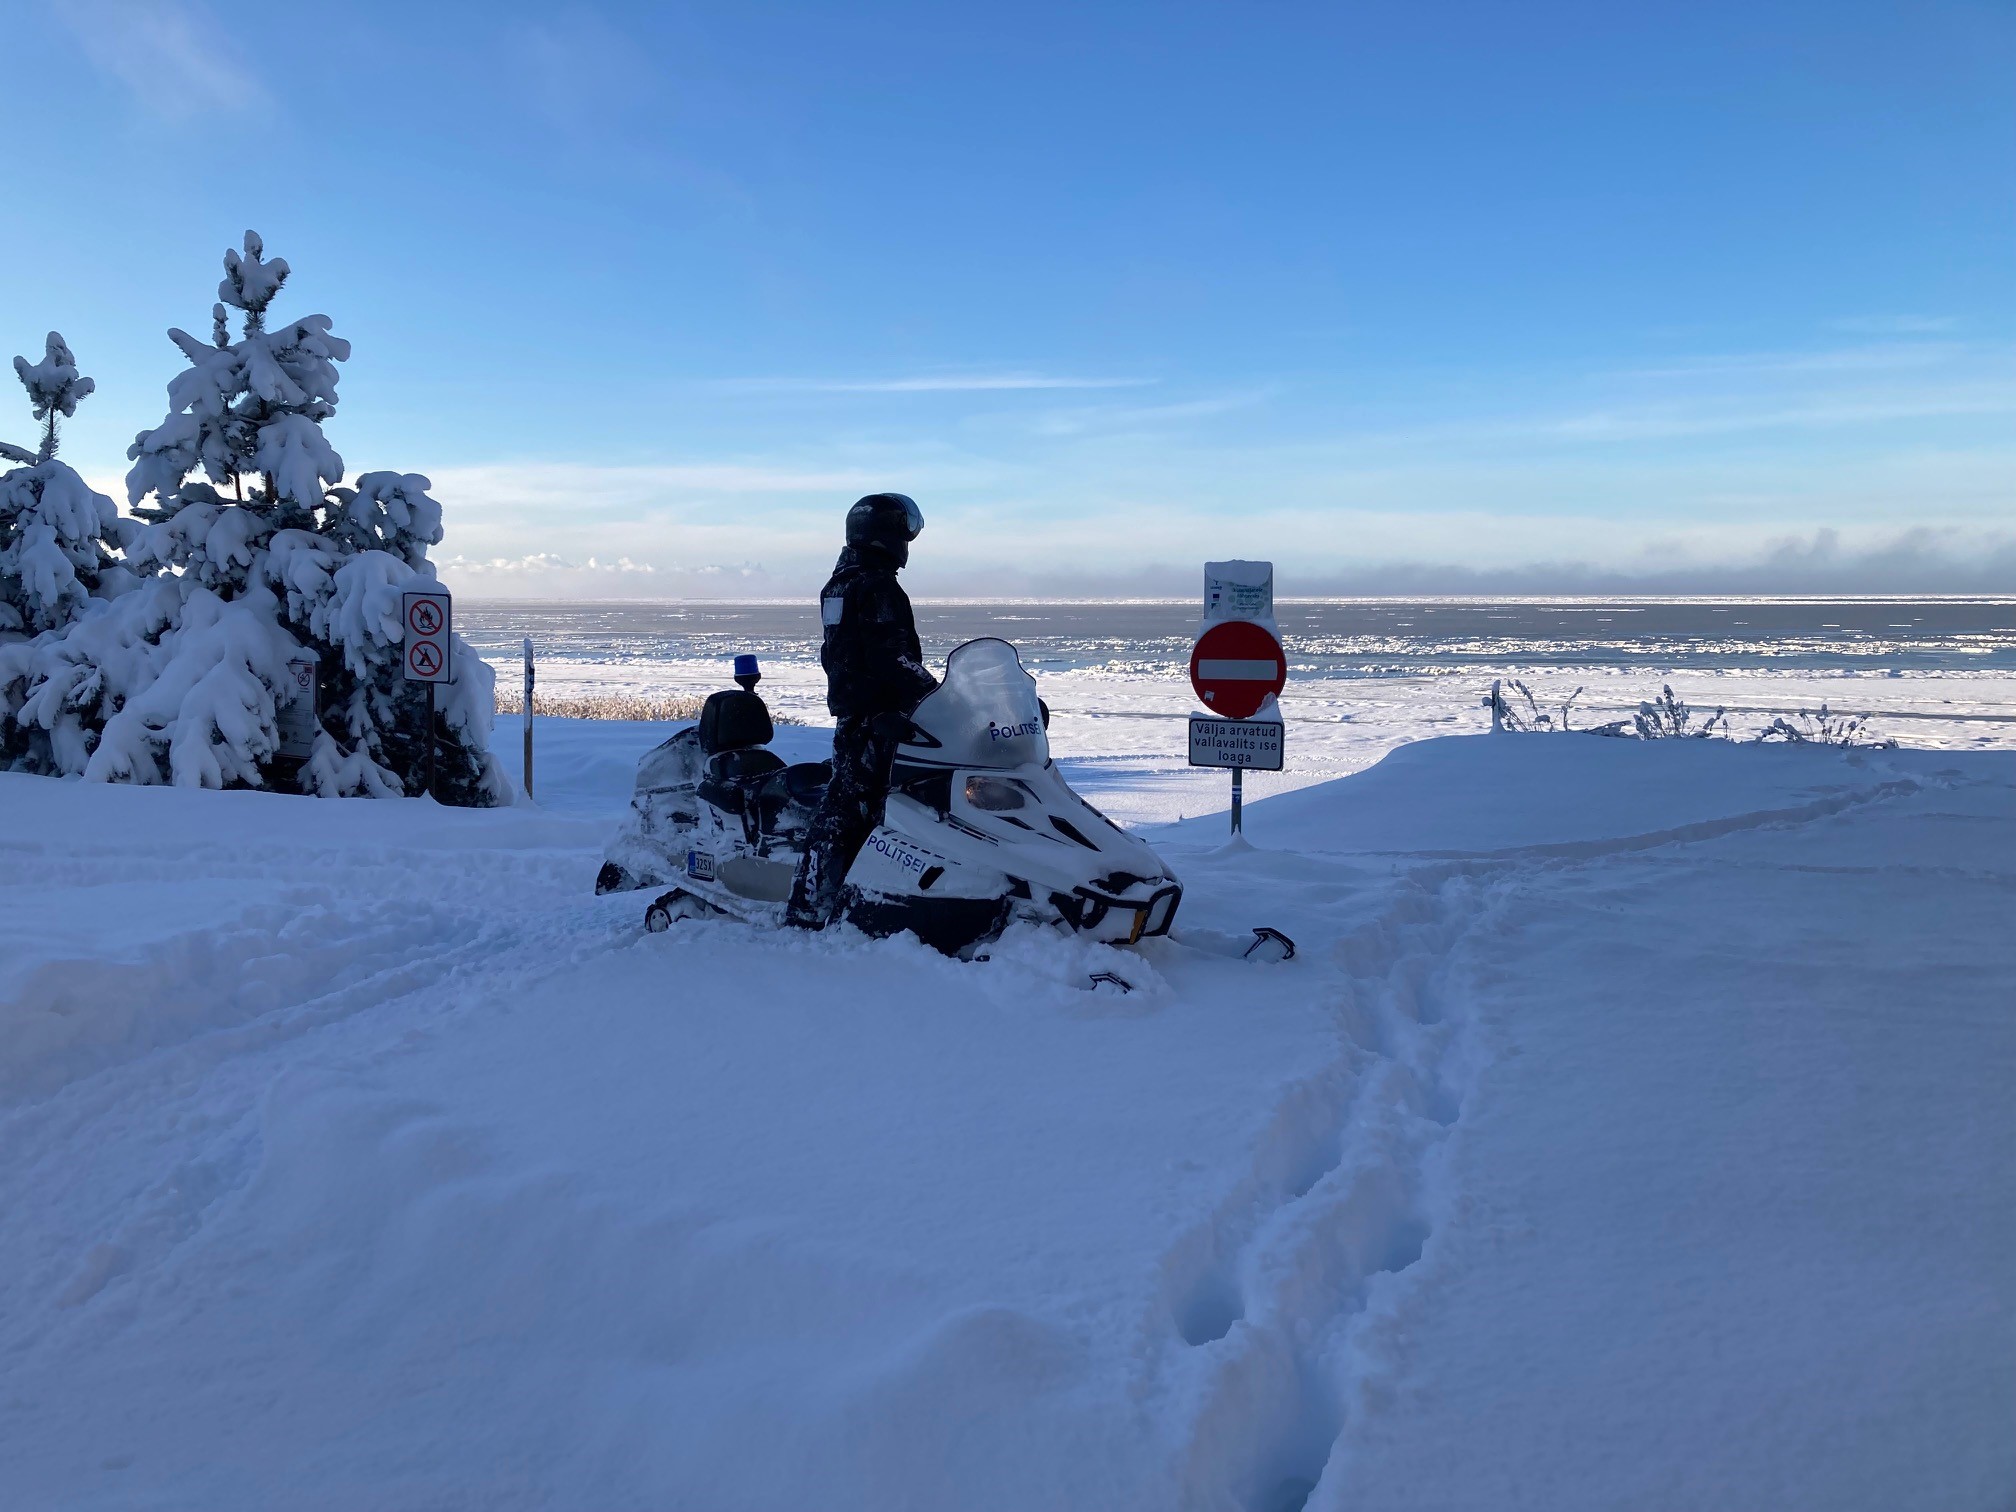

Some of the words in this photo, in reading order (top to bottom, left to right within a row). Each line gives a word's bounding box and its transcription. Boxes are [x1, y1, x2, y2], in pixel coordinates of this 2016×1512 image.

[1196, 723, 1226, 737] Välja
[1229, 726, 1276, 737] arvatud
[1195, 737, 1256, 750] vallavalits
[1218, 750, 1252, 764] loaga
[867, 834, 926, 874] POLITSEI
[696, 857, 712, 871] 32SX
